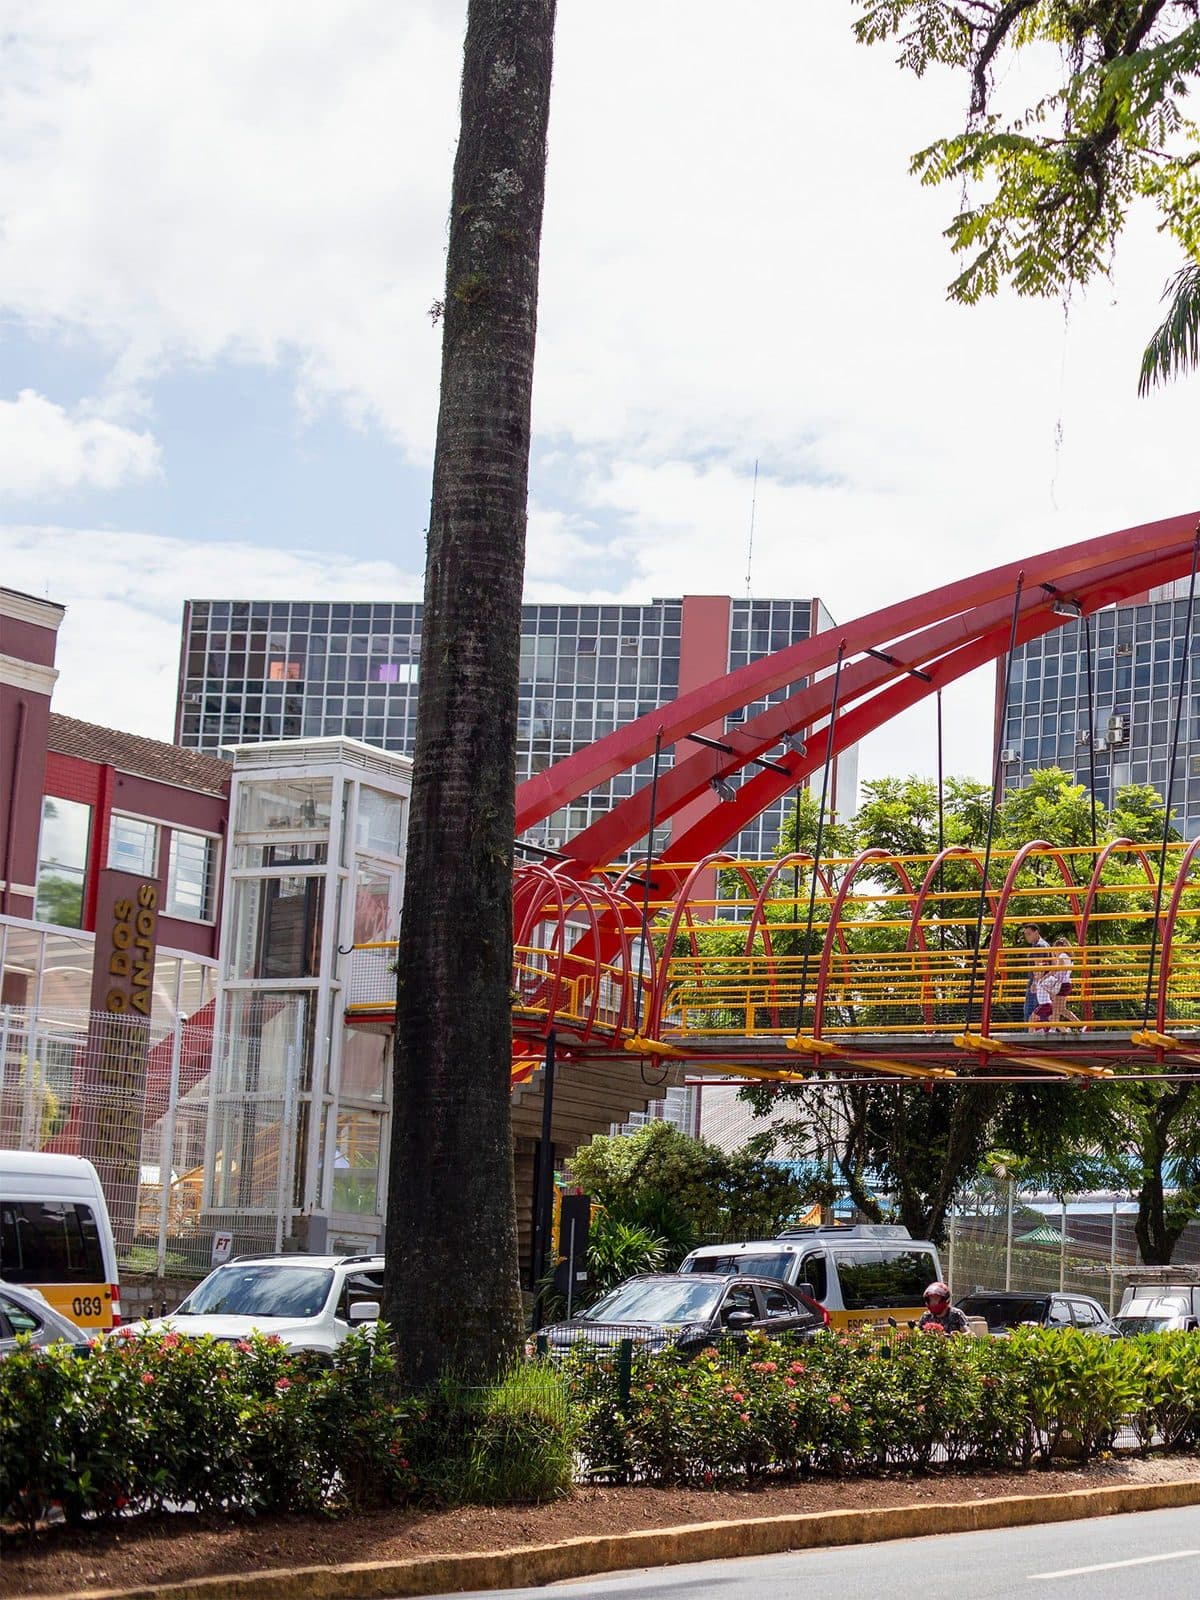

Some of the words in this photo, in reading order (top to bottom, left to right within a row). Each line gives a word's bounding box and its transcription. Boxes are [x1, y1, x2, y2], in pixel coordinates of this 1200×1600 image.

[111, 899, 133, 977] DOS
[131, 884, 157, 1016] ANJOS
[215, 1238, 231, 1250] FT
[72, 1297, 102, 1316] 089
